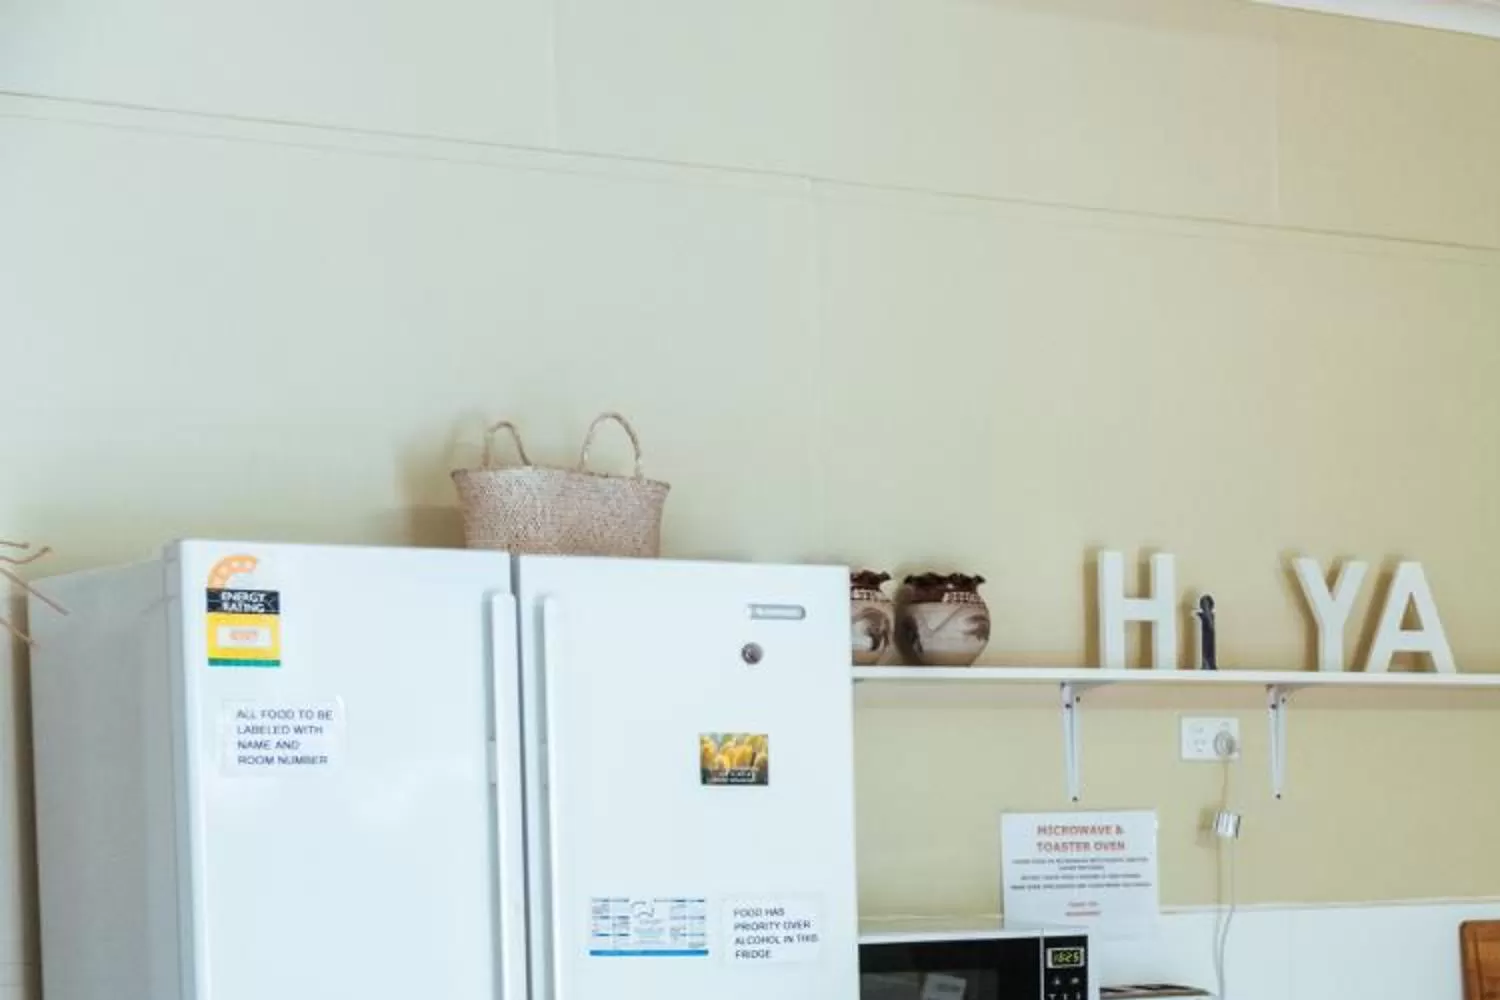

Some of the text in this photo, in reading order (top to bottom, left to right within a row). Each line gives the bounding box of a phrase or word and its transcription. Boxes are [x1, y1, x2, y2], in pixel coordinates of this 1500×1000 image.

[221, 591, 266, 602] ENERGY
[222, 602, 265, 612] RATING
[237, 709, 333, 720] ALL FOOD TO BE
[237, 725, 323, 734] LABELED WITH
[237, 740, 300, 750] NAME AND
[238, 755, 328, 765] ROOM NUMBER
[1037, 824, 1113, 836] MICROWAVE
[1036, 841, 1125, 852] TOASTER OVEN
[733, 907, 785, 917] FOOD HAS
[734, 920, 810, 931] PRIORITY OVER
[735, 933, 818, 945] ALCOHOL IN THIS
